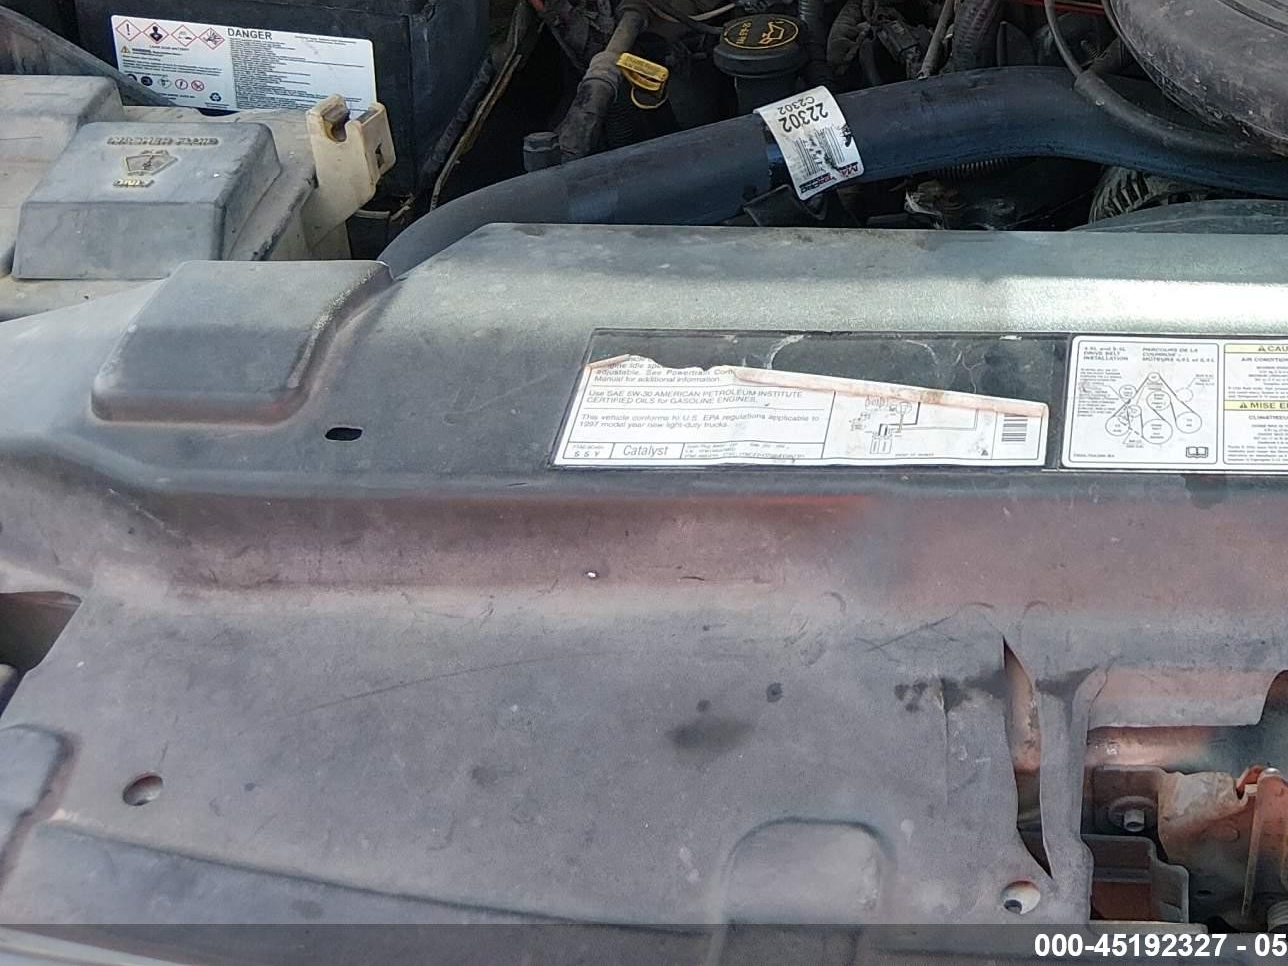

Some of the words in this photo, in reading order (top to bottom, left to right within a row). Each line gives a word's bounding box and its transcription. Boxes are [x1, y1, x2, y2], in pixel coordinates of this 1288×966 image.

[227, 27, 273, 40] DANGER
[777, 96, 815, 115] C2302
[779, 102, 829, 133] 22302
[702, 389, 756, 397] PETROLEUM
[758, 390, 803, 398] INSTITUTE
[722, 413, 766, 421] regulations
[767, 414, 809, 422] applicable
[627, 421, 646, 429] year
[623, 444, 669, 458] Catalyst
